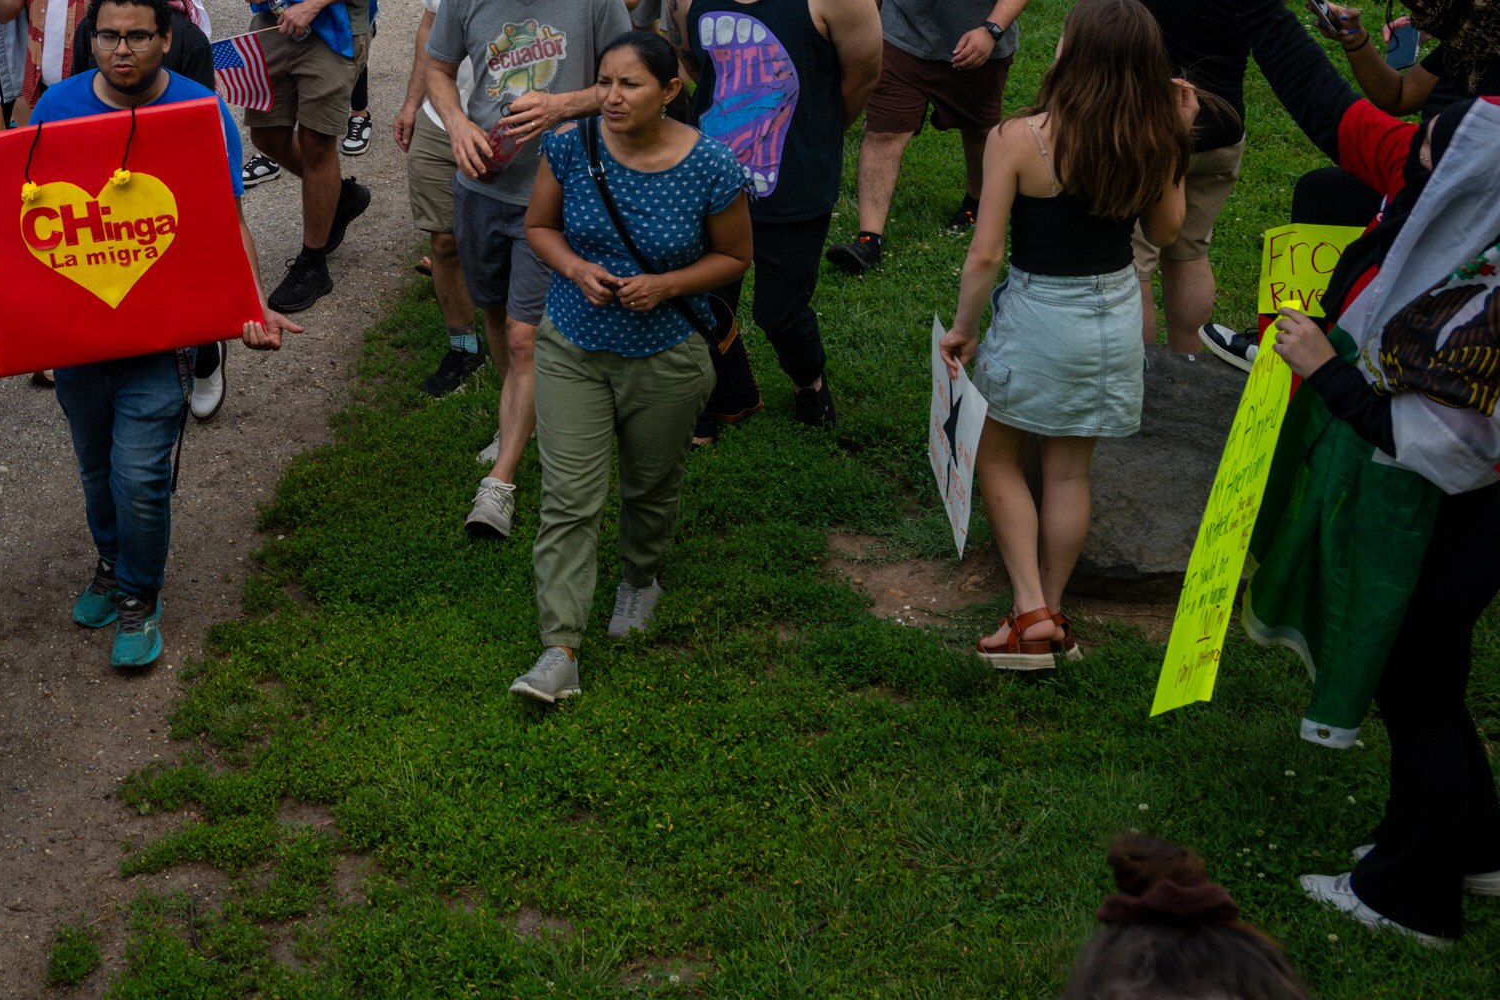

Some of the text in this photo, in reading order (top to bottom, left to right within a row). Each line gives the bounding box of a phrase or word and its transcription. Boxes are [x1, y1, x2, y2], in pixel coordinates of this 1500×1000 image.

[488, 37, 564, 72] ecuador
[713, 43, 794, 98] TITLE
[22, 200, 179, 251] CHinga
[50, 246, 159, 269] La migra
[1269, 230, 1338, 276] Fro
